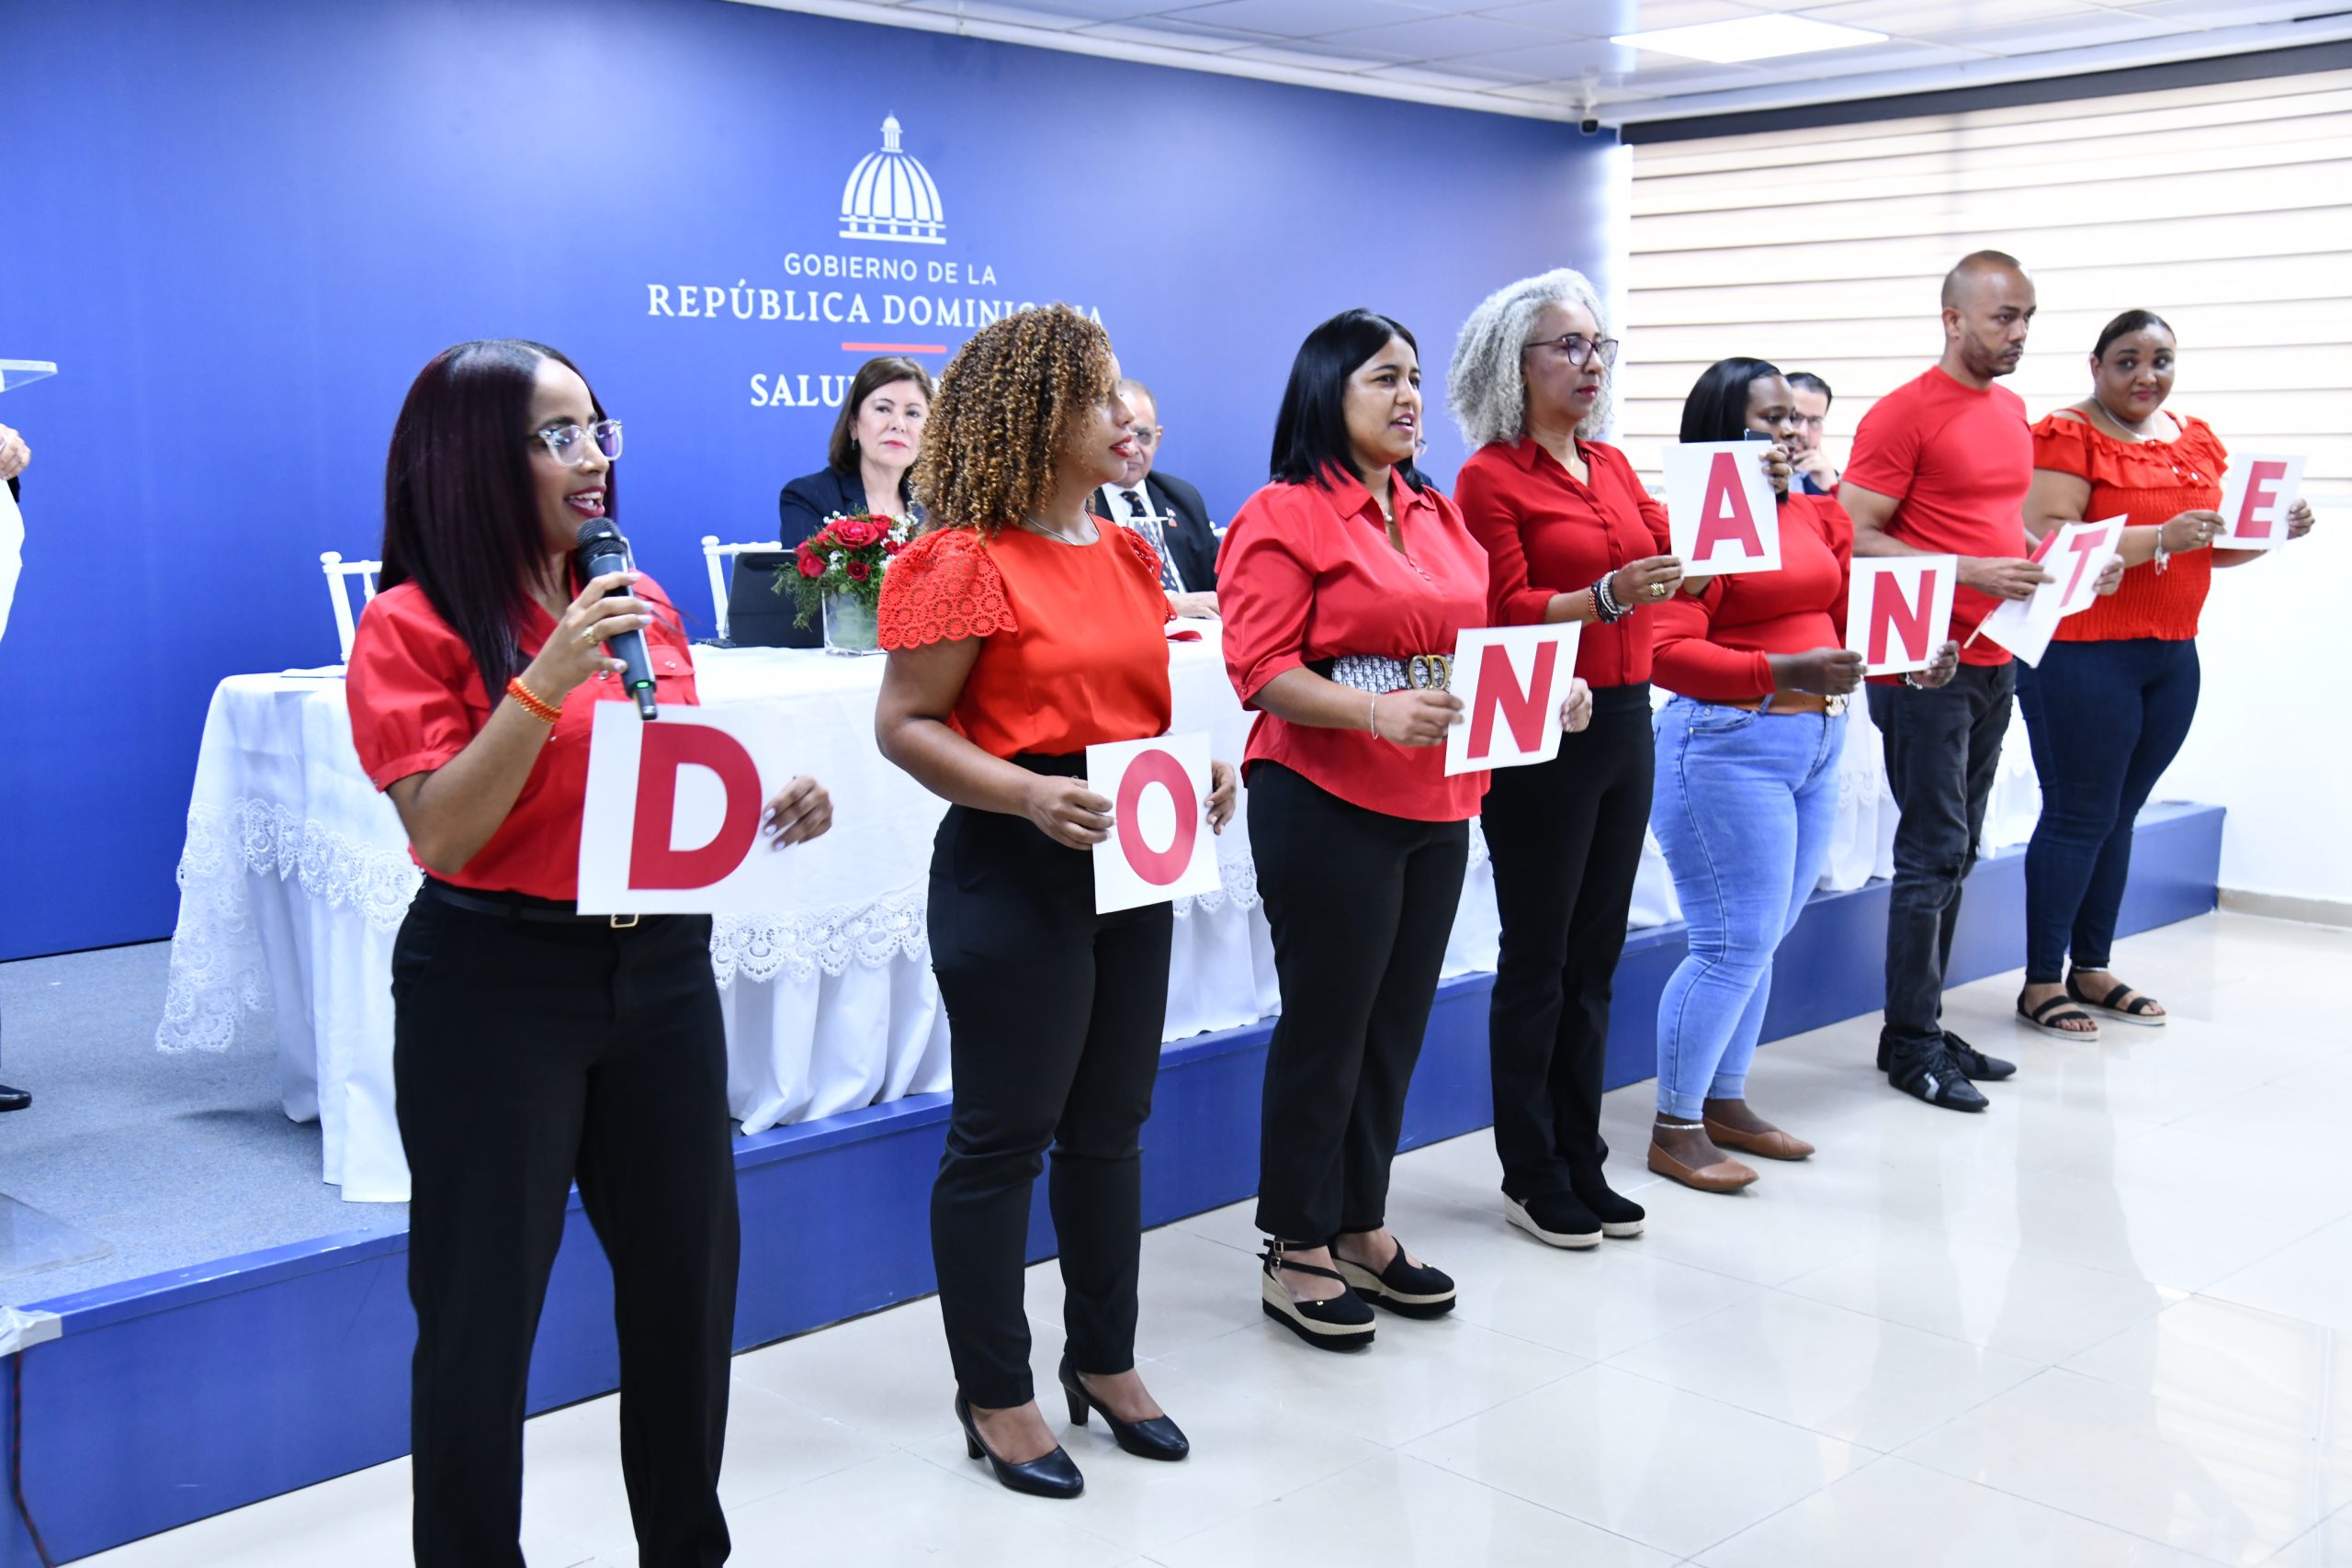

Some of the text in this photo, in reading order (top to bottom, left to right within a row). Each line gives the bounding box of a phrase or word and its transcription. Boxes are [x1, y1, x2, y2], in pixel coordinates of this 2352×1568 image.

[646, 278, 1103, 328] REPÚBLICA DOMINIA
[784, 252, 998, 286] GOBIERNO DE LA
[750, 373, 856, 408] SALU
[1691, 451, 1765, 561] A
[2233, 461, 2288, 539] E
[2059, 527, 2109, 608] T
[1867, 570, 1937, 665] N
[1466, 640, 1559, 760] N
[628, 721, 763, 890] D
[1115, 749, 1198, 886] O
